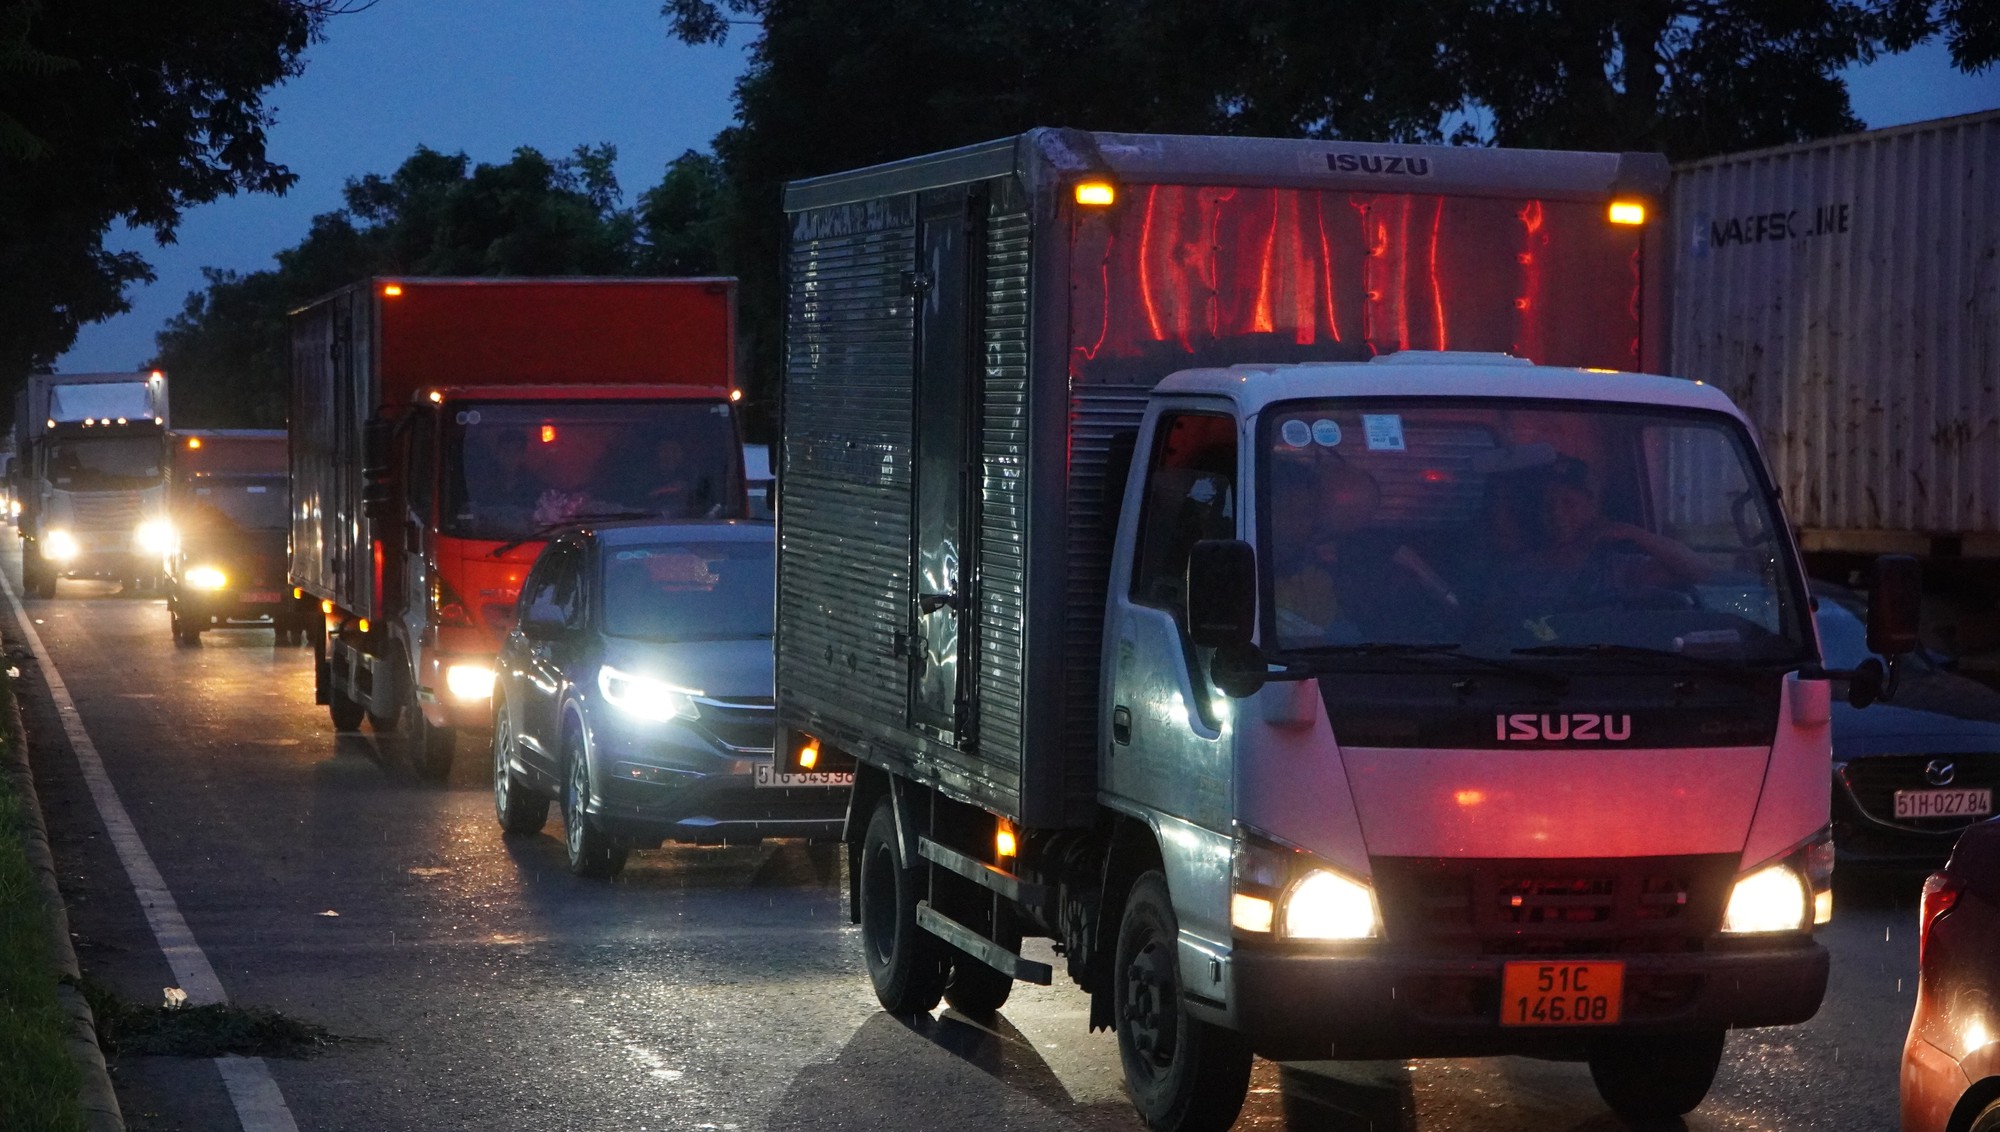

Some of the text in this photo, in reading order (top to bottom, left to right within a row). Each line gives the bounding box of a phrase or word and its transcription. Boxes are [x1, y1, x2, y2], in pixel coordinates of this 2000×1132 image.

[1326, 153, 1428, 176] ISUZU
[1806, 204, 1849, 237] INE
[480, 588, 521, 598] HIN
[1496, 714, 1631, 741] ISUZU
[1897, 793, 1988, 815] 51H-027.84
[1538, 966, 1588, 992] 51C
[1517, 996, 1608, 1022] 146.08
